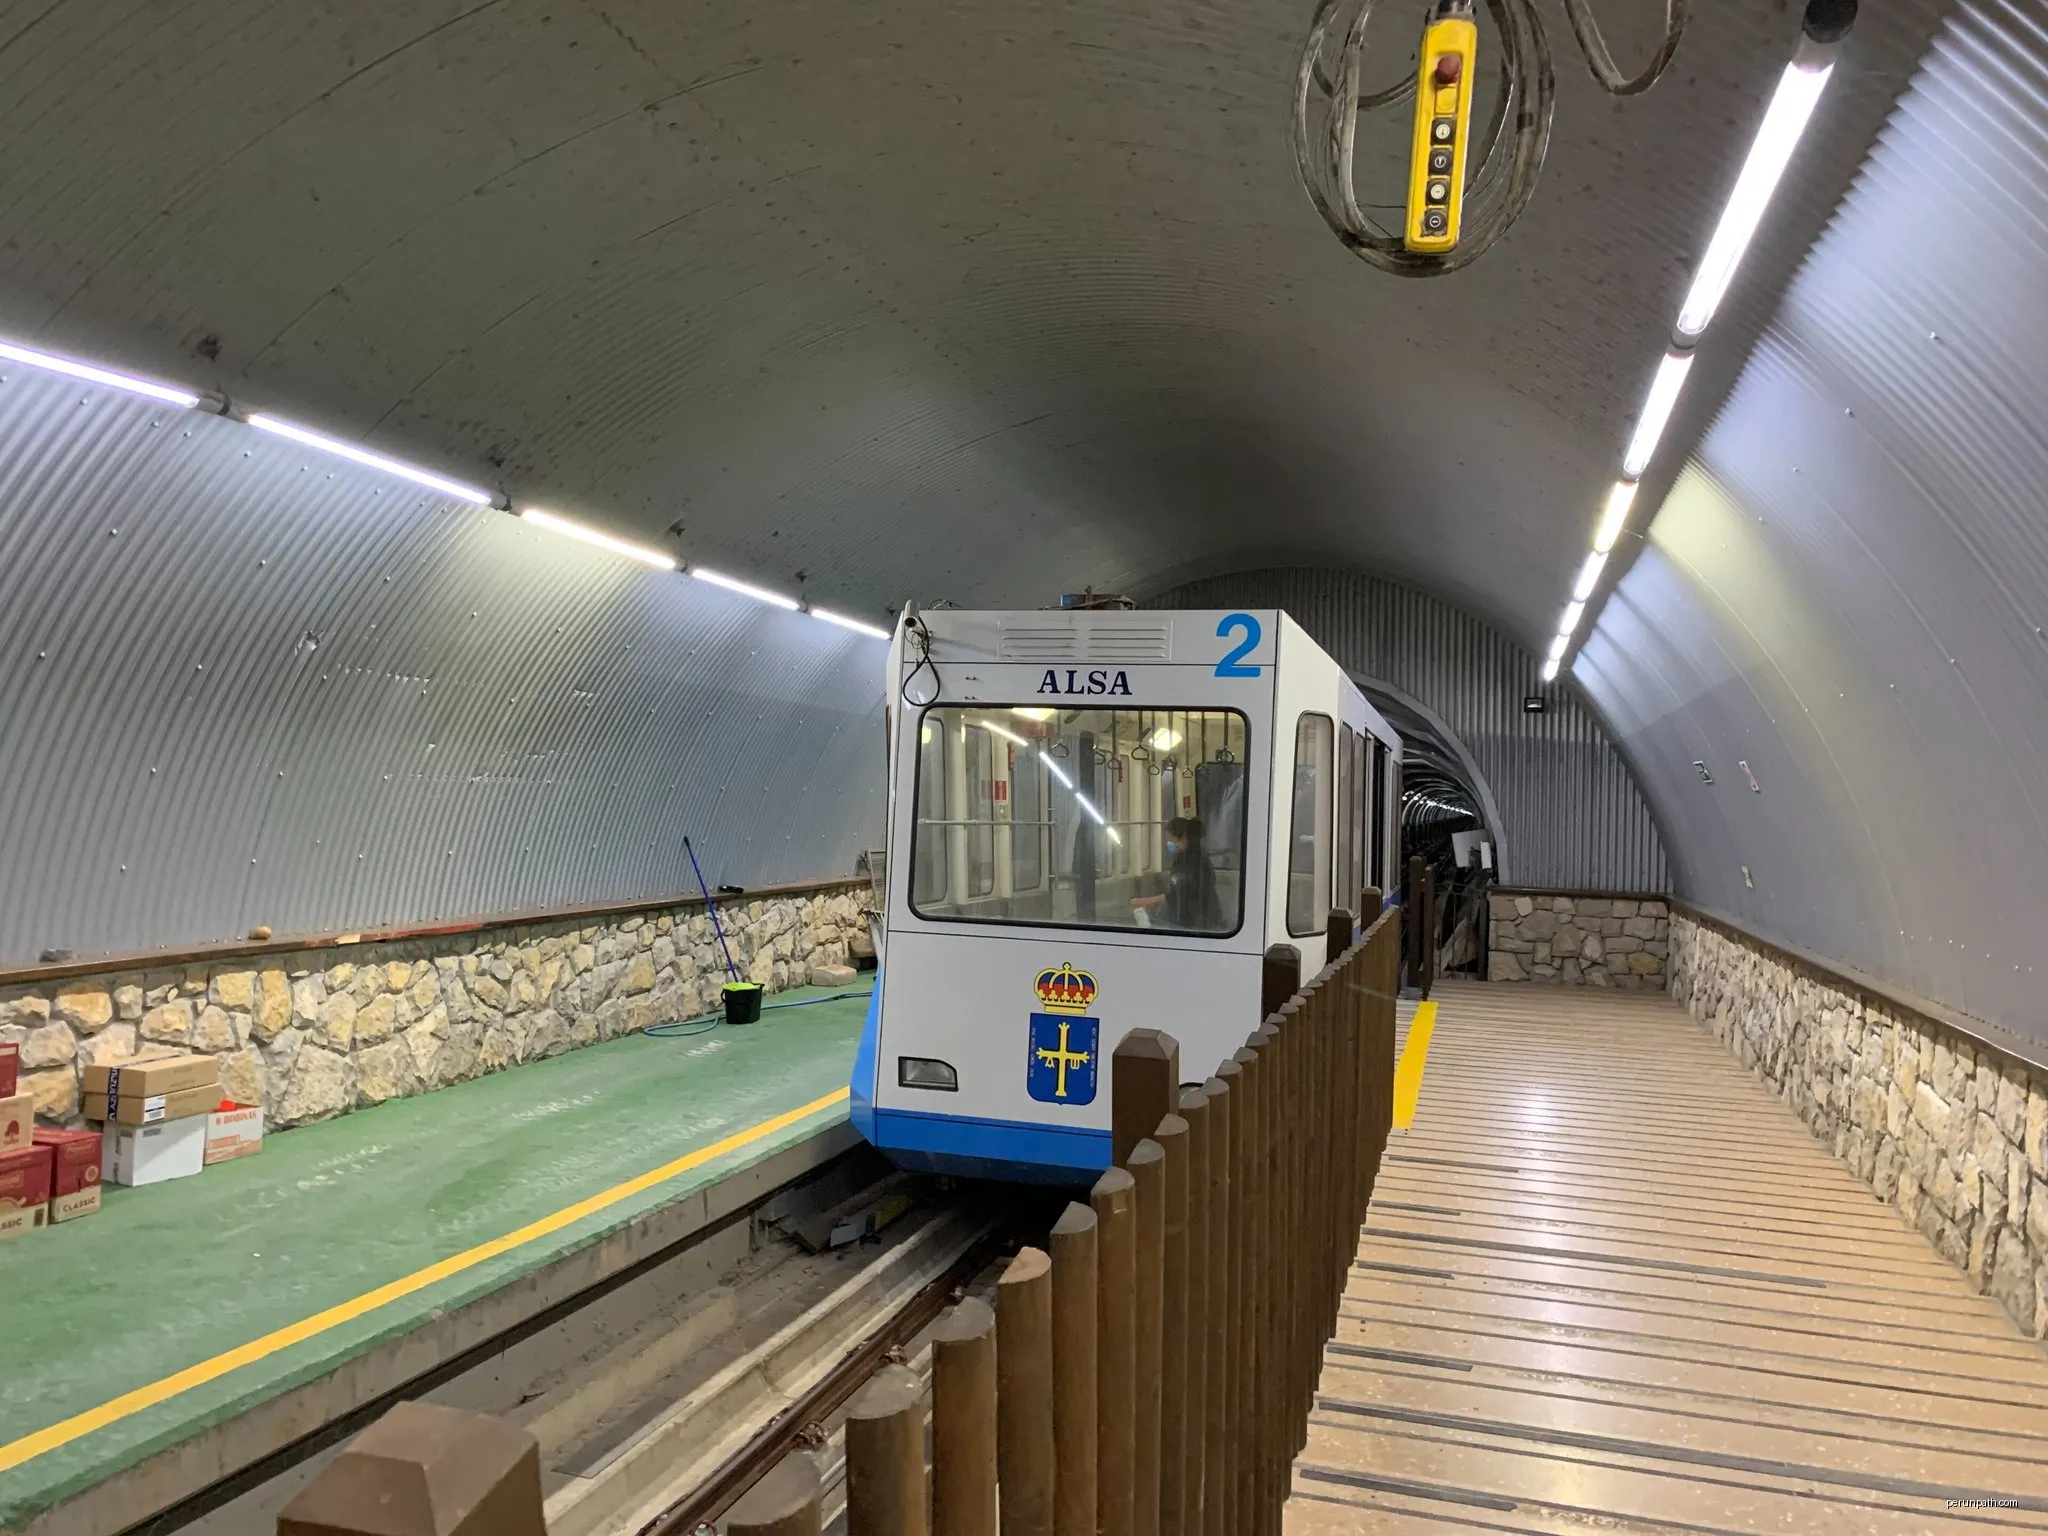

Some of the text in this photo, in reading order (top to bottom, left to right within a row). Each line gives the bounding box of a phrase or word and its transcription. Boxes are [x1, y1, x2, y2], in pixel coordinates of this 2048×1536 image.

[1214, 613, 1262, 678] 2
[1036, 669, 1133, 696] ALSA
[62, 1196, 97, 1213] CLASSIC
